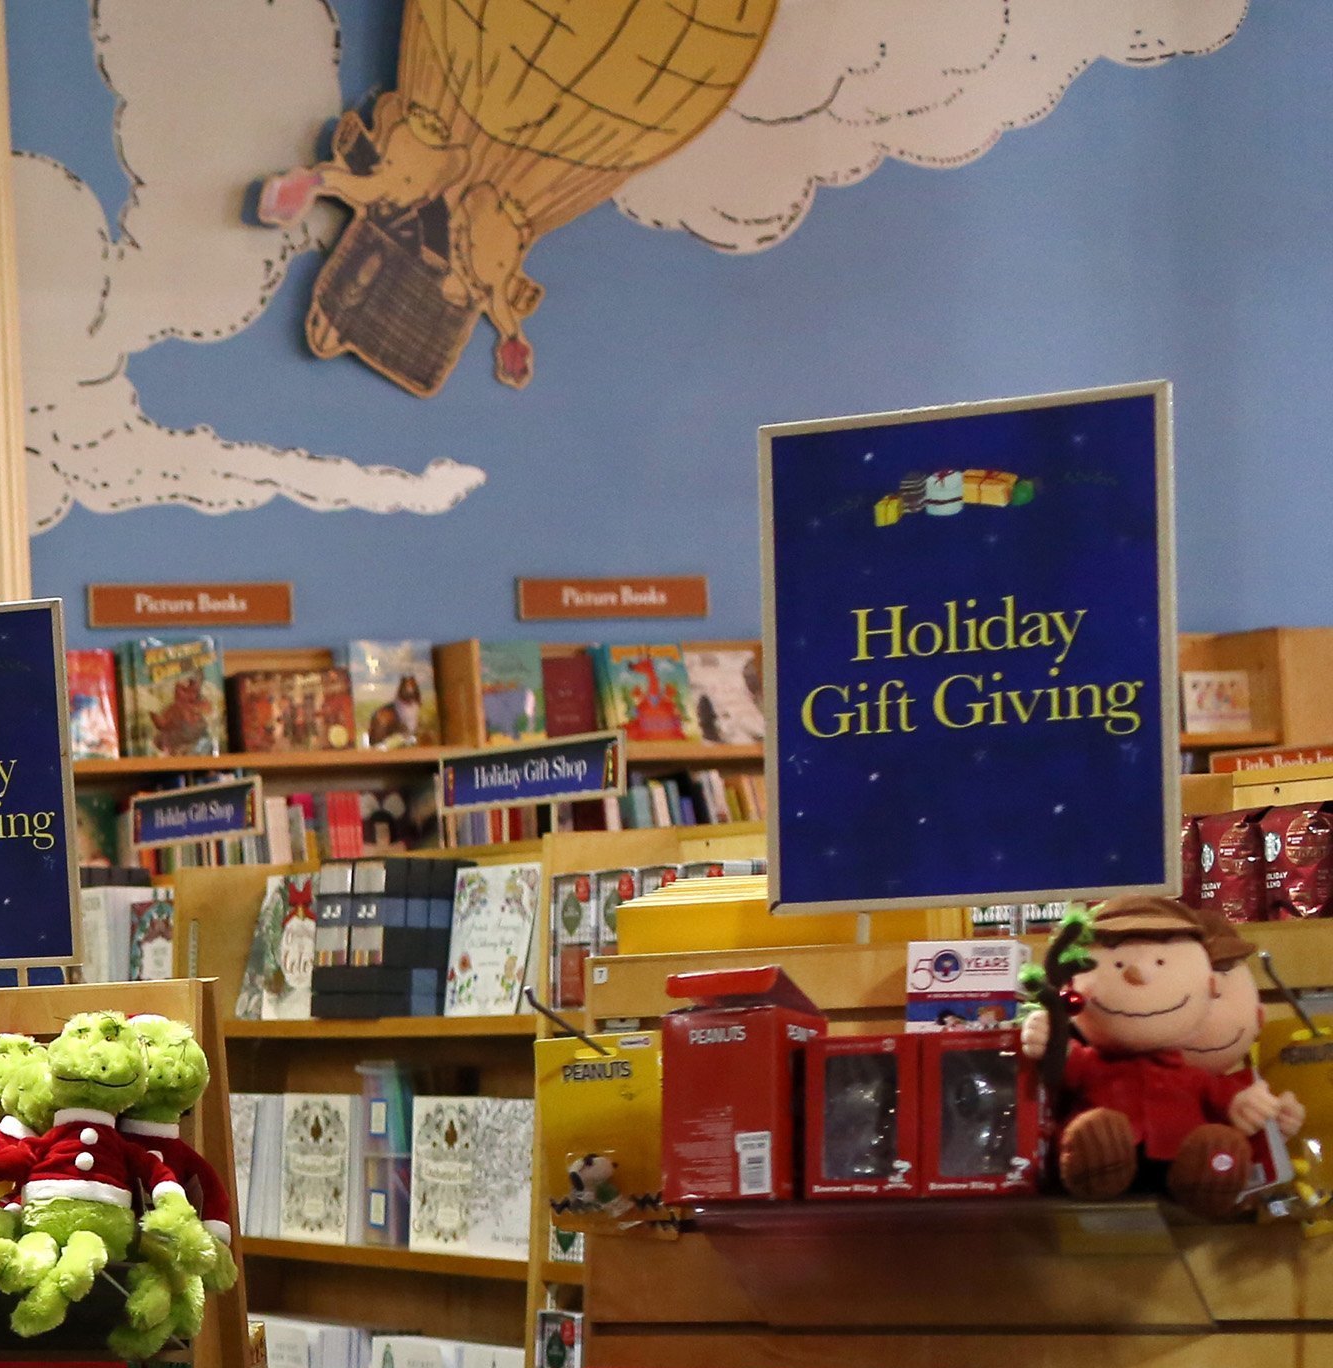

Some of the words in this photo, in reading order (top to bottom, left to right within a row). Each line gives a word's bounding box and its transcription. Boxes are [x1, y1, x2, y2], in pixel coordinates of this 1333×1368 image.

[134, 593, 195, 613] Picture
[197, 592, 247, 612] Books
[561, 585, 619, 607] Picture
[619, 584, 667, 606] Books
[850, 594, 1089, 664] Holiday
[801, 679, 919, 738] Gift
[932, 666, 1145, 736] Giving
[473, 763, 521, 790] Holiday
[523, 758, 549, 781] Gift
[553, 754, 587, 781] Shop
[154, 806, 187, 829] Holiday
[188, 800, 207, 822] Gift
[209, 800, 234, 823] Shop
[965, 957, 1010, 968] YEARS
[689, 1025, 747, 1044] PEANUTS
[563, 1061, 631, 1082] PEANUTS
